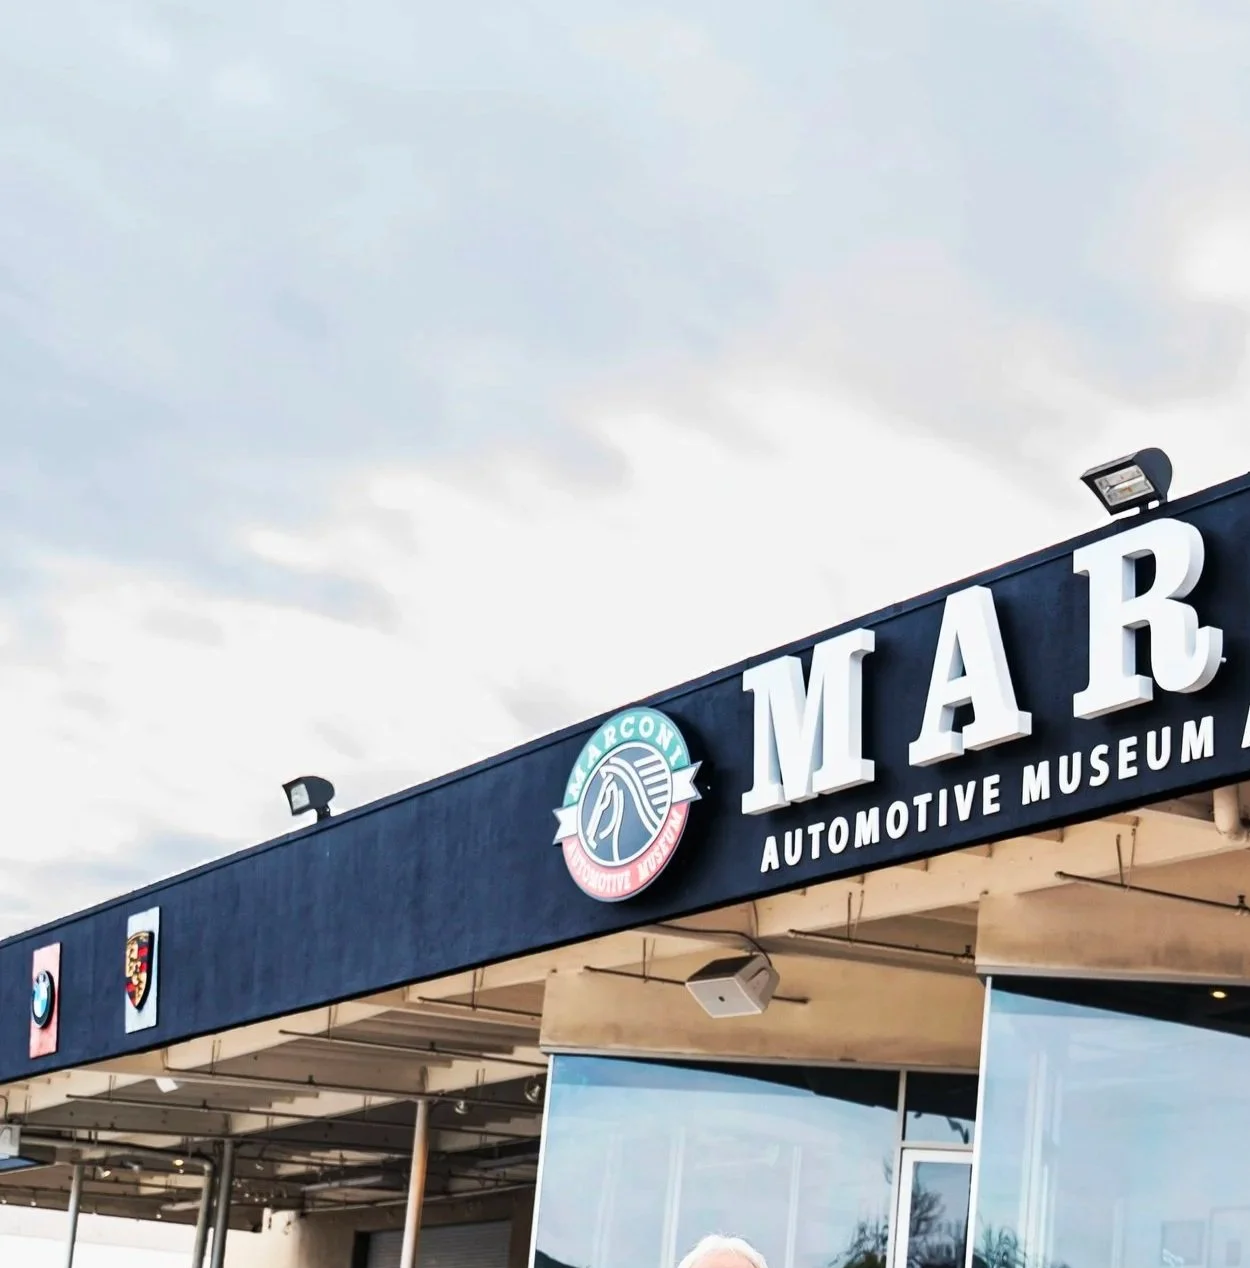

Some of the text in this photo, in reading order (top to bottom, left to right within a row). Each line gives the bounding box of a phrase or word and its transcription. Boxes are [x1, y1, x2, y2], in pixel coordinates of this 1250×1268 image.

[569, 715, 682, 797] MARCONI
[760, 774, 1002, 873] AUTOMOTIVE
[1021, 715, 1214, 806] MUSEUM
[565, 809, 683, 893] AUTOMOTIVE MUSEUM
